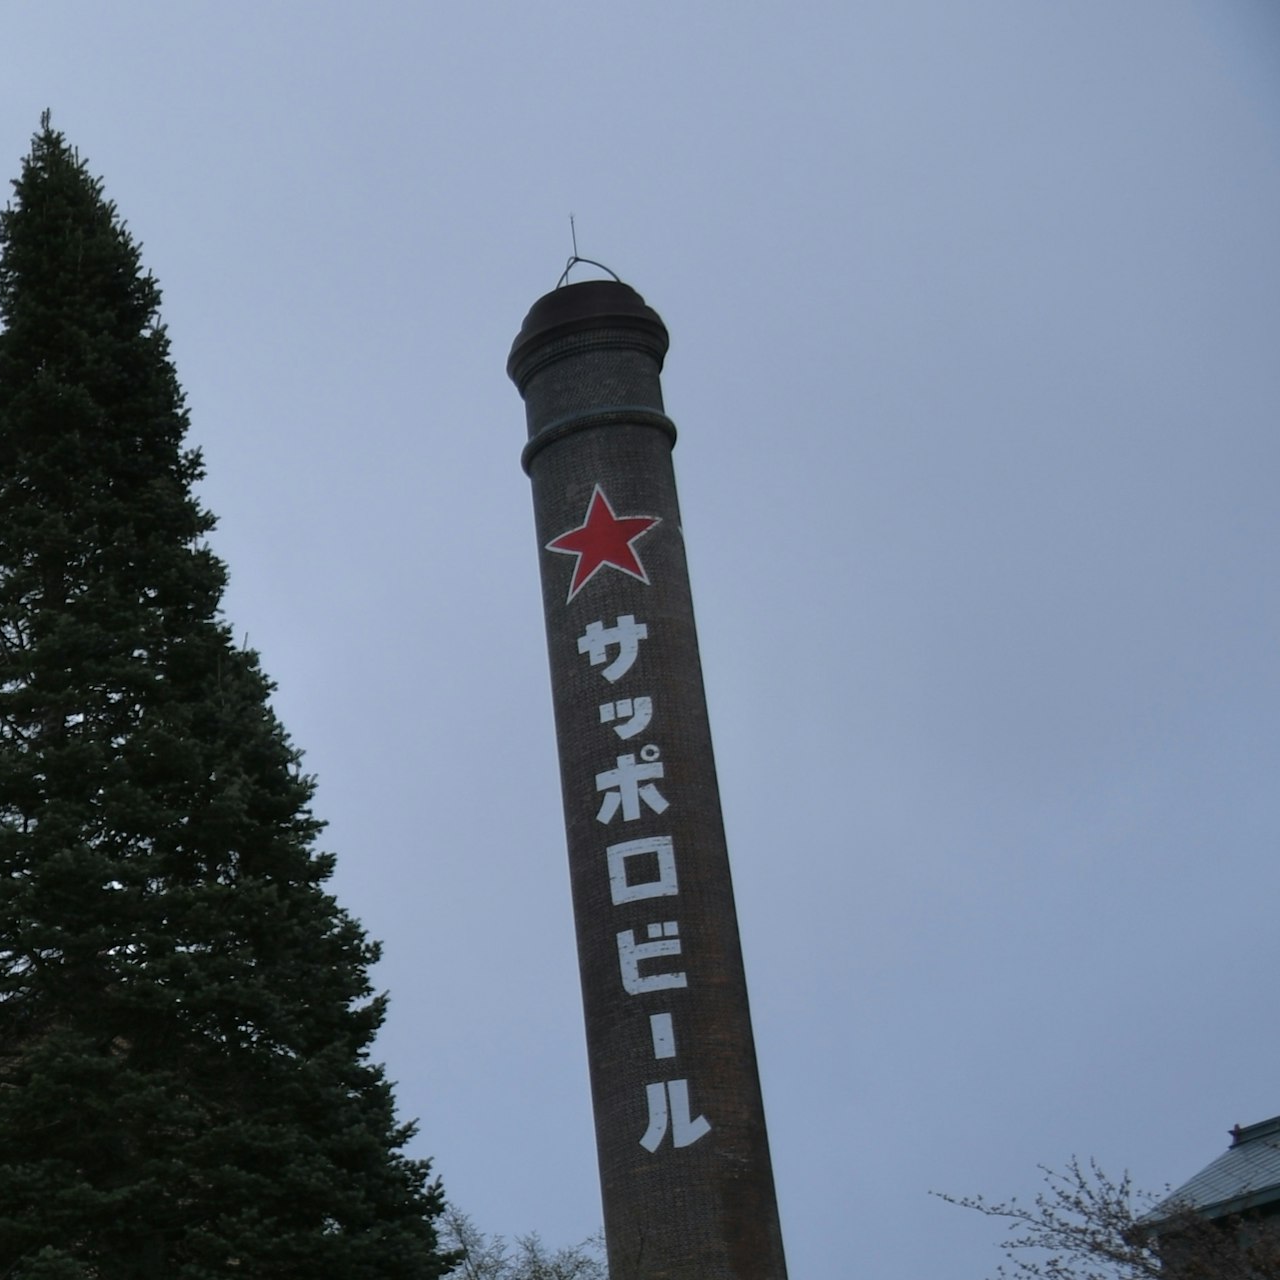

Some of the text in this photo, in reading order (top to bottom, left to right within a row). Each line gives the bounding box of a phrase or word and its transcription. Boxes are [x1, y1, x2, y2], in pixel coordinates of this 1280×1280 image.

[577, 613, 712, 1154] サッポロビール
